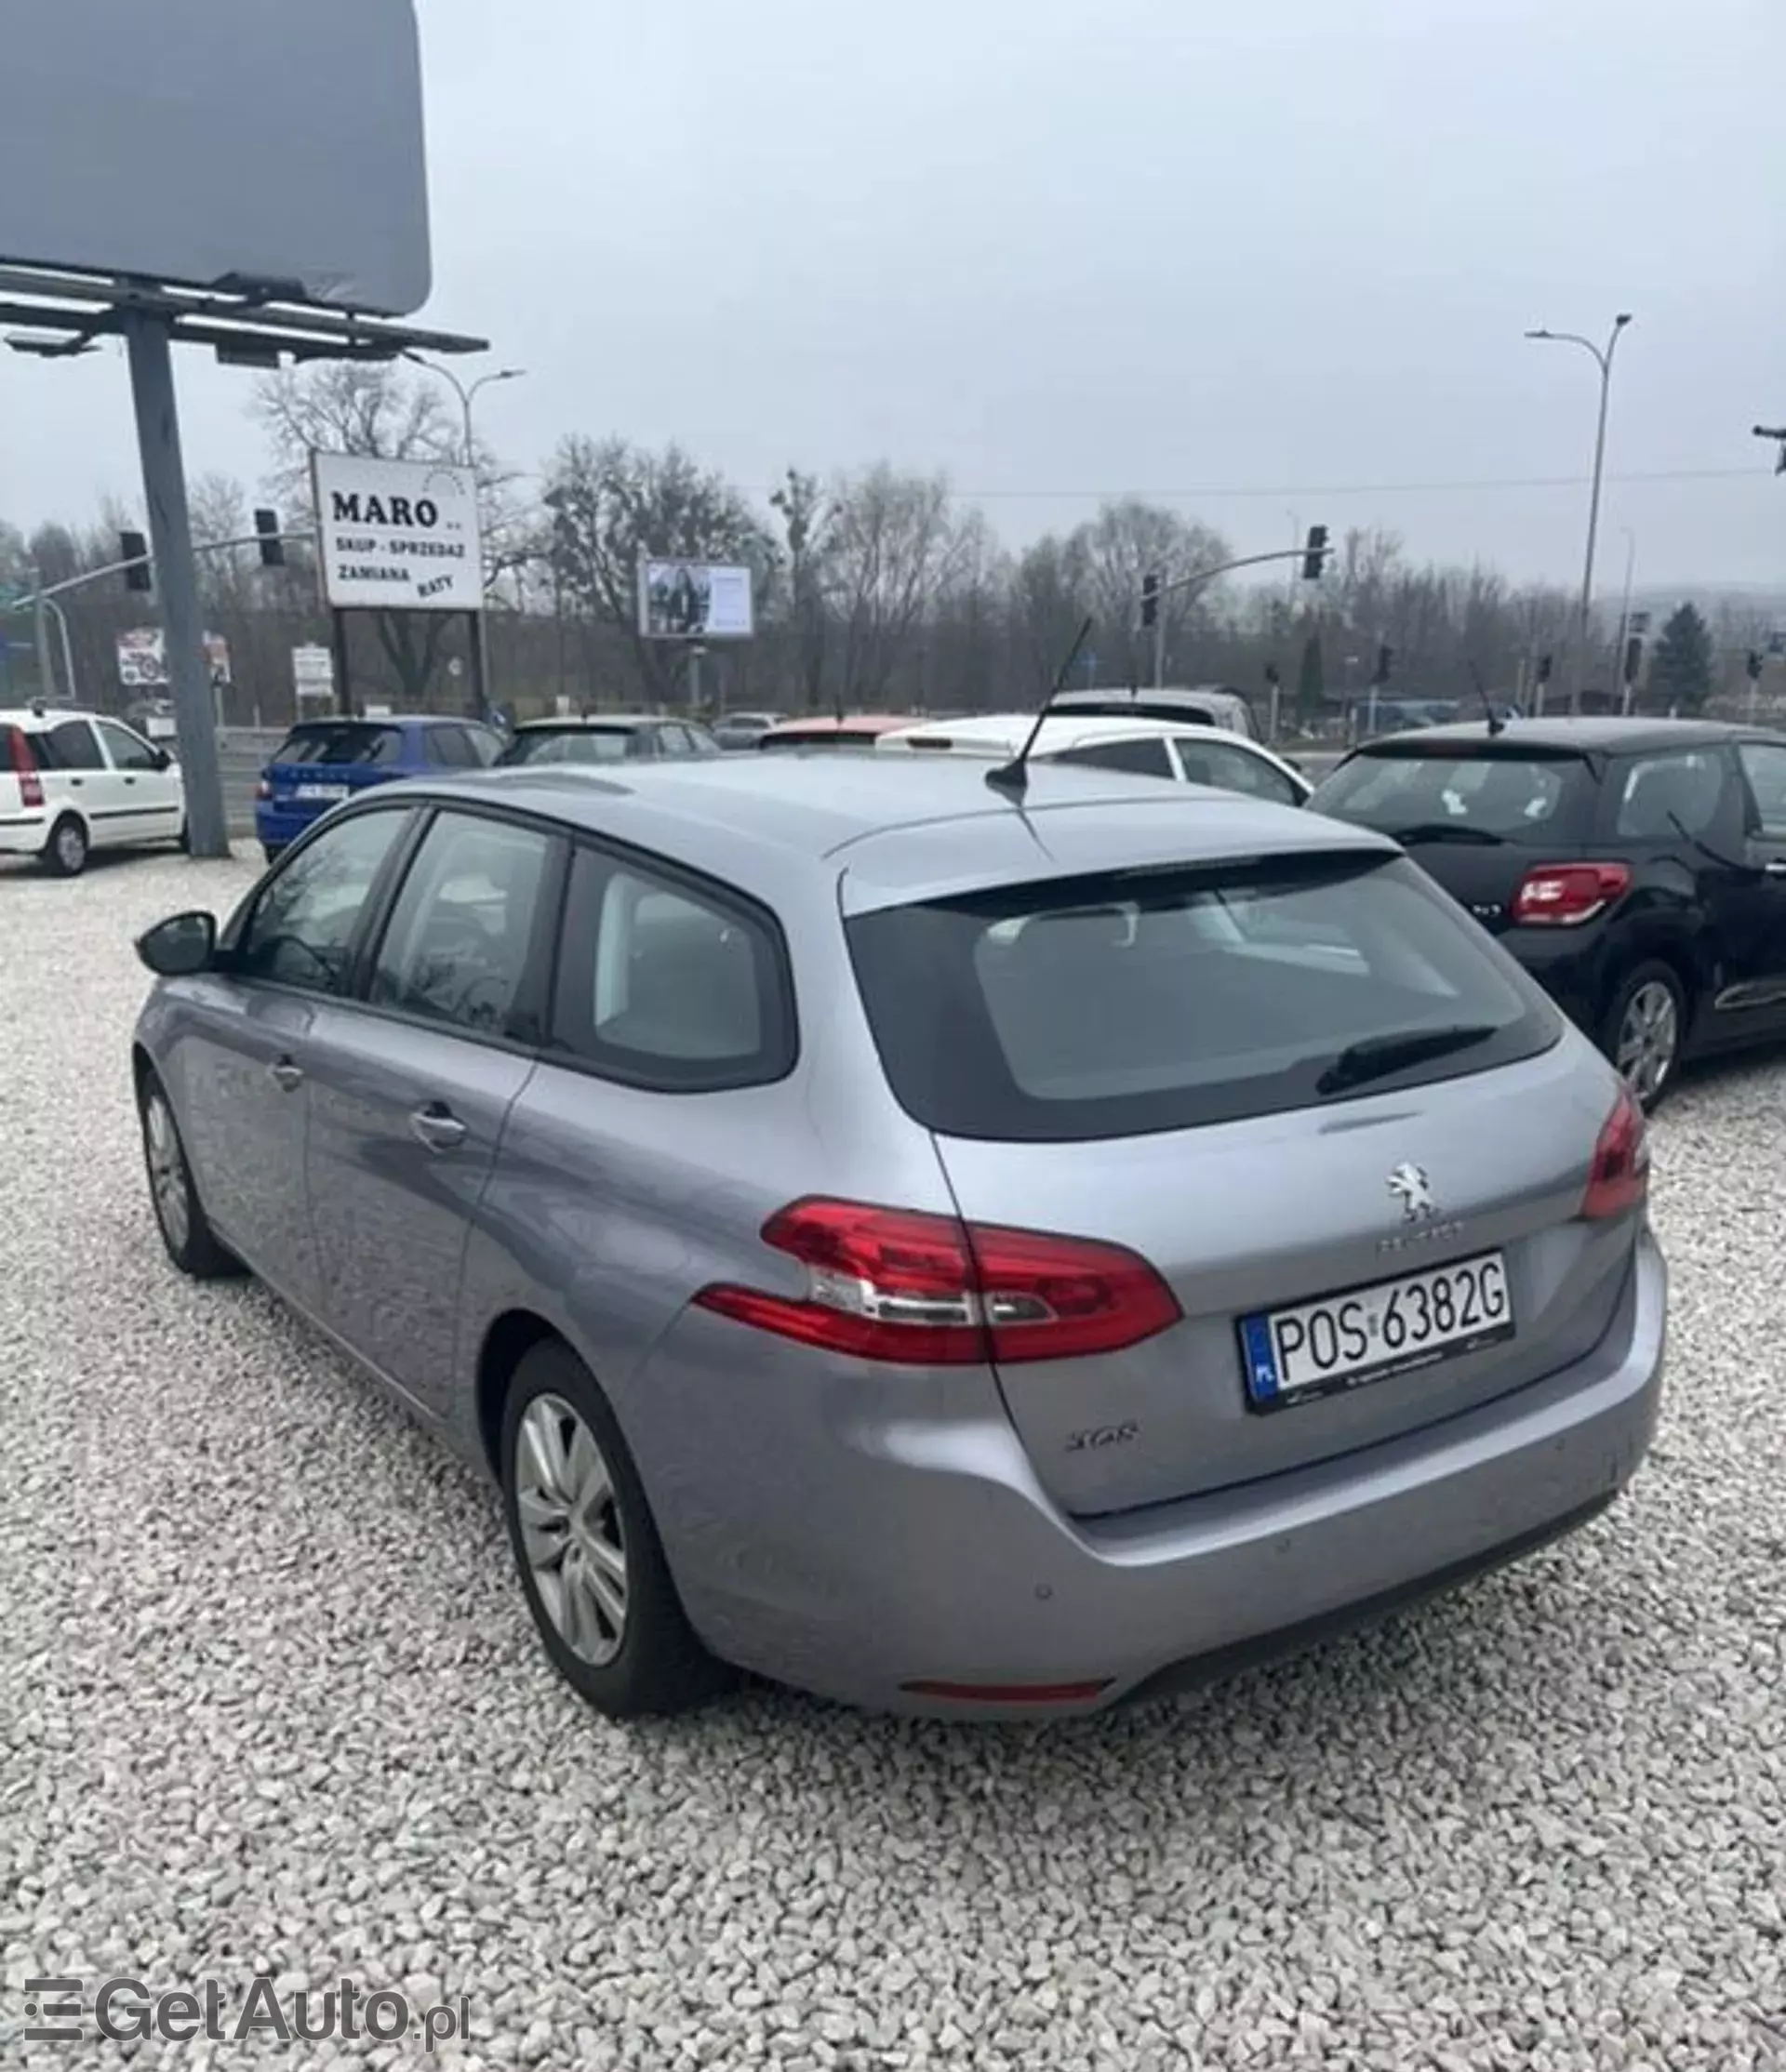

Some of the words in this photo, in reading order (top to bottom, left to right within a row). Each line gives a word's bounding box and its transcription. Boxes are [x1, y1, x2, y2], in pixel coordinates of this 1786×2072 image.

[331, 491, 438, 528] MARO
[336, 537, 376, 552] SKUP
[338, 564, 409, 581] ZAMIANA
[417, 575, 453, 597] RATY
[1275, 1302, 1368, 1382] POS
[1382, 1262, 1504, 1349] 6382G
